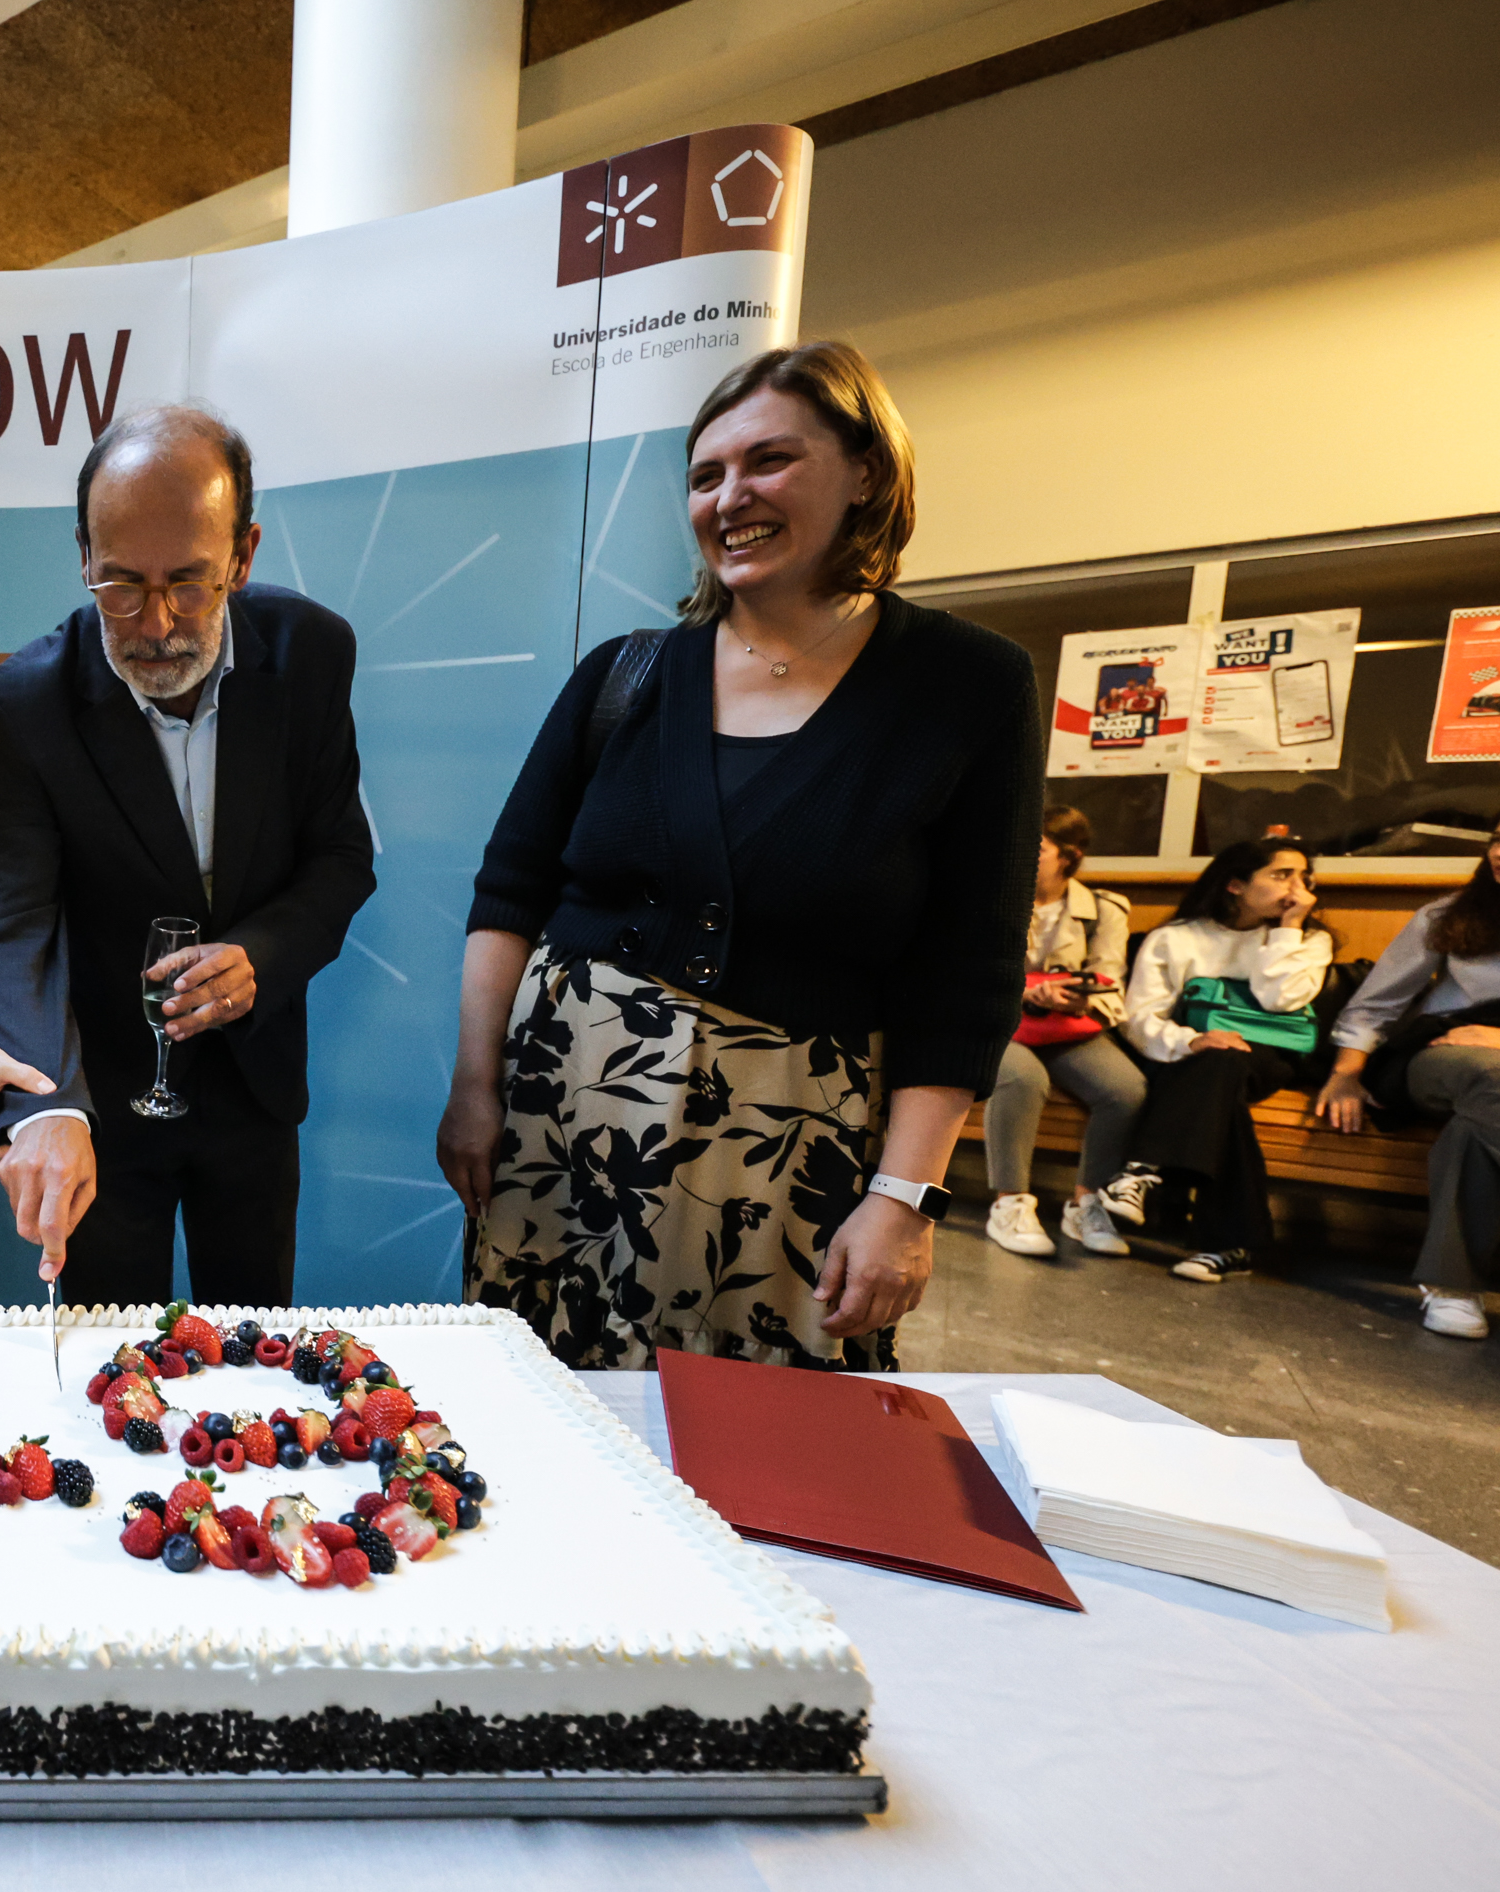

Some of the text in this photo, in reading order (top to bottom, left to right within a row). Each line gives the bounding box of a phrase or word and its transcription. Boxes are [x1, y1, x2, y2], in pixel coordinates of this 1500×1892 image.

[553, 301, 780, 349] Universidade do Minho
[551, 330, 739, 376] Escola de Engenharia
[1214, 639, 1268, 651] WANT
[1222, 652, 1266, 667] YOU
[1101, 729, 1138, 739] YOU
